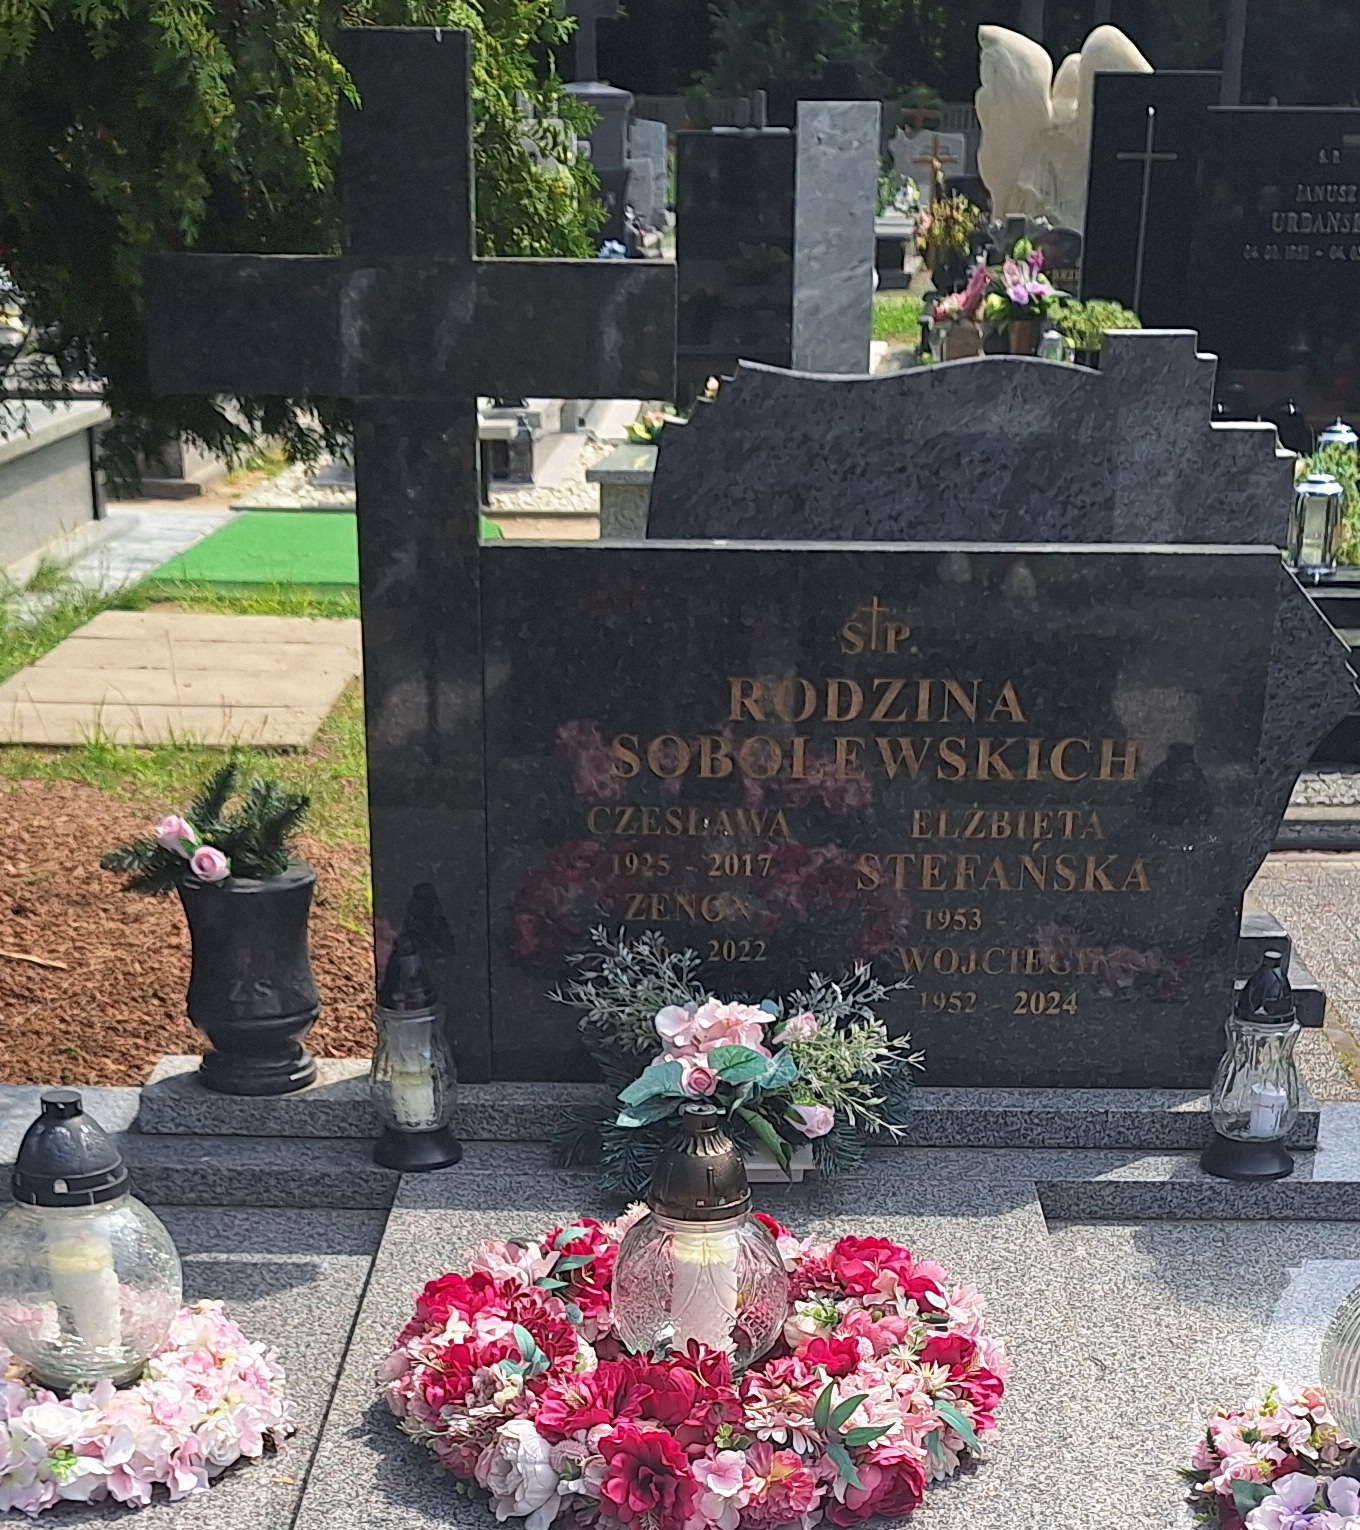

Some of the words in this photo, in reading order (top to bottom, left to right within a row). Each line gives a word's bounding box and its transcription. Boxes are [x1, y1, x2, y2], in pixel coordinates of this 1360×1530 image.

[727, 677, 1028, 725] RODZINA
[608, 733, 1140, 783] SOBOLEWSKICH
[587, 805, 793, 838] CZESŁAWA
[707, 852, 774, 878] 2017
[856, 840, 1152, 893] STEFAŃSKA
[922, 907, 983, 932] 1953
[707, 938, 768, 963] 2022
[895, 944, 1102, 977] WOJCIECH
[919, 989, 978, 1014] 1952
[1012, 989, 1080, 1016] 2024
